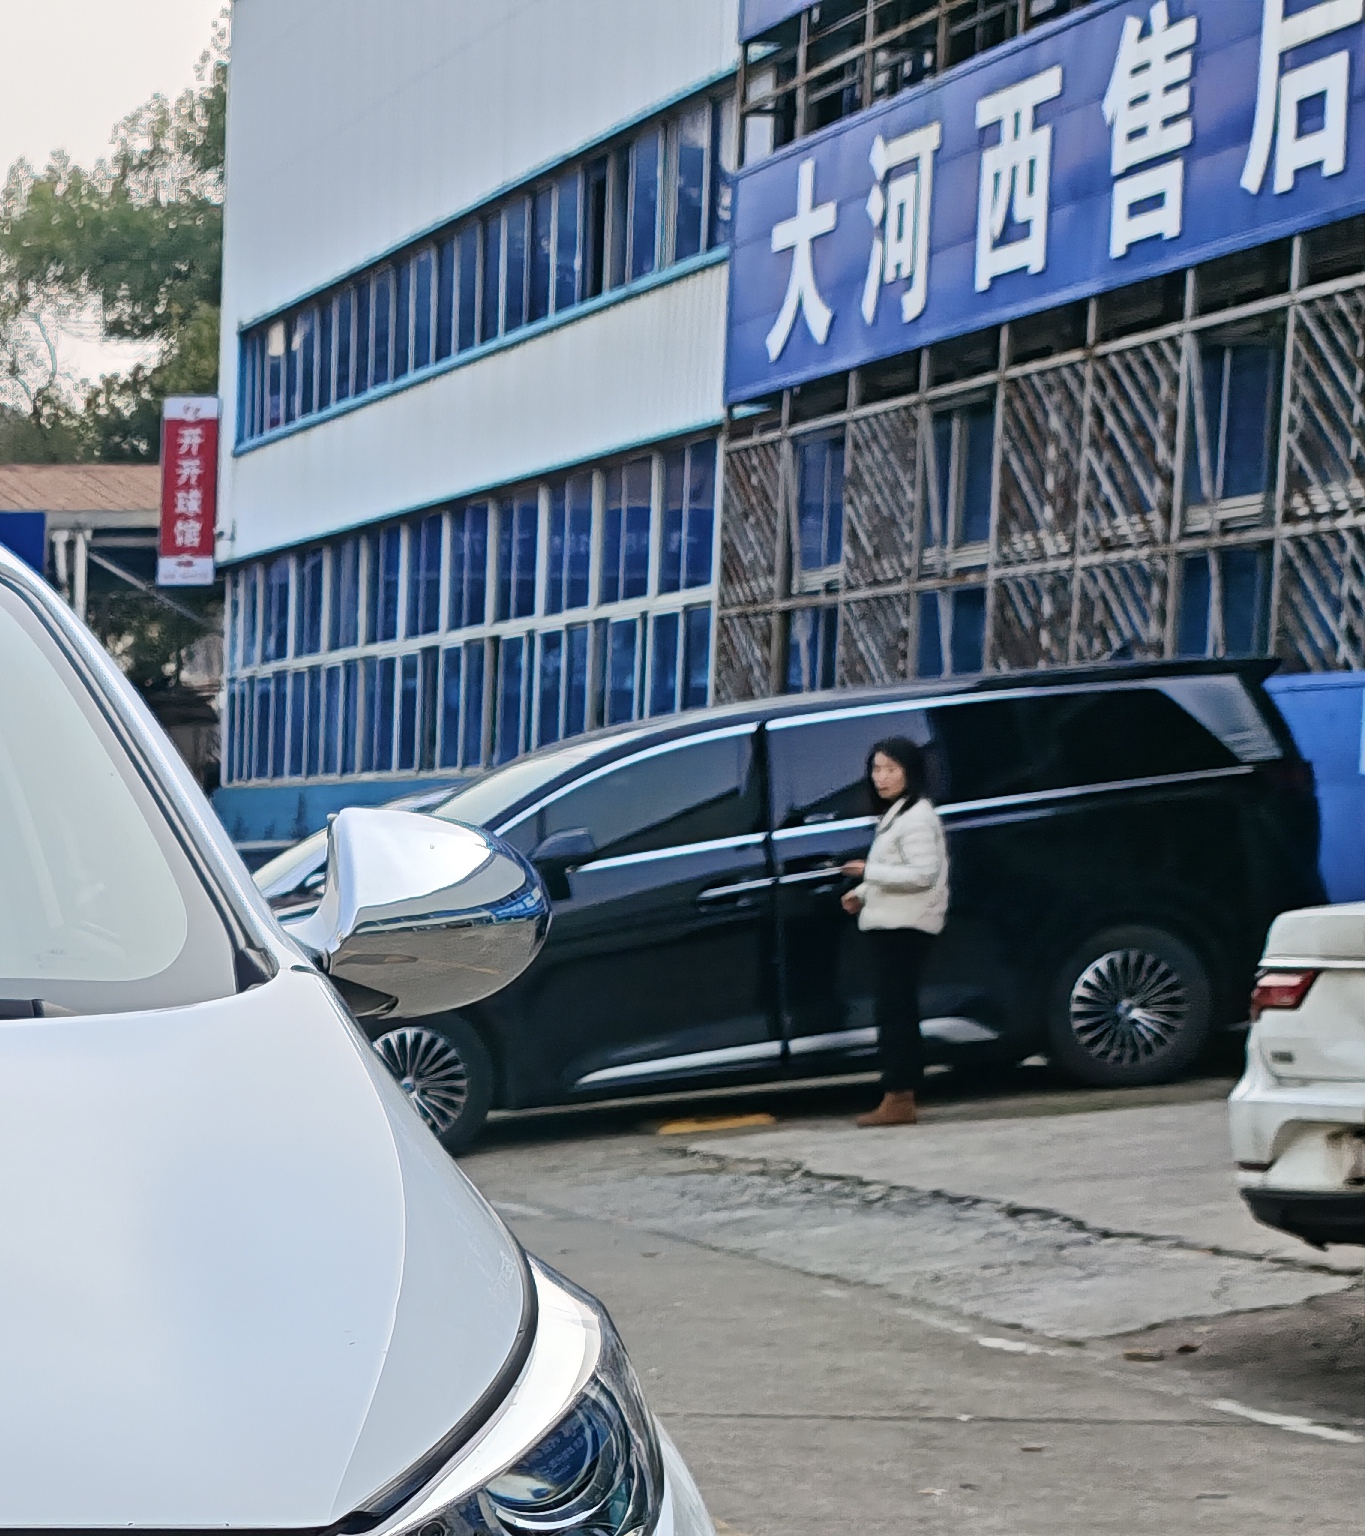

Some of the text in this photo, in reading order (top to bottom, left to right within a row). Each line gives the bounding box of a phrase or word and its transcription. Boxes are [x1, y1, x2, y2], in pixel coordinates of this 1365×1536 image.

[765, 0, 1365, 362] 大河西售后
